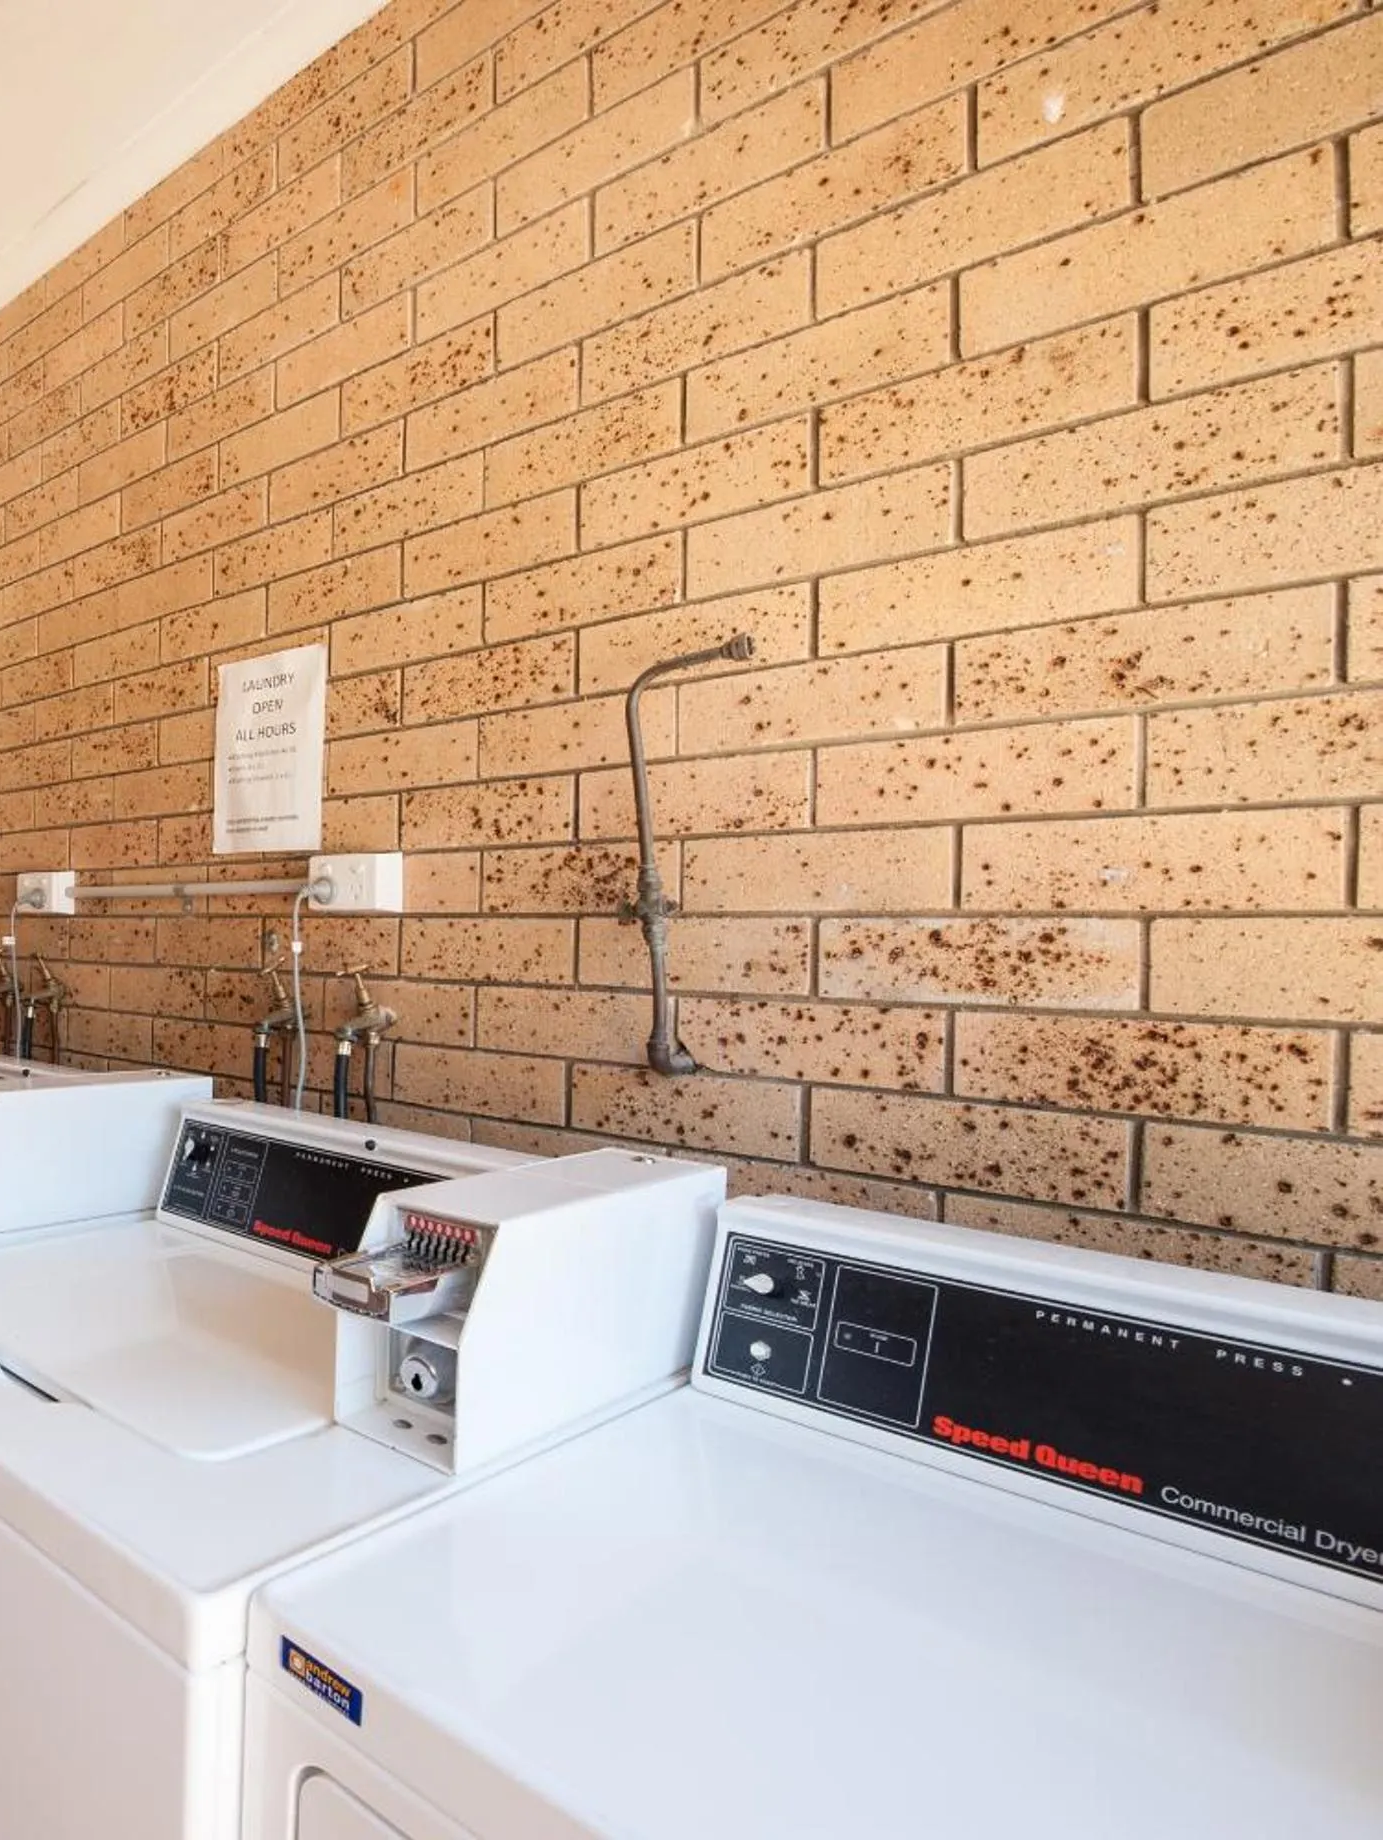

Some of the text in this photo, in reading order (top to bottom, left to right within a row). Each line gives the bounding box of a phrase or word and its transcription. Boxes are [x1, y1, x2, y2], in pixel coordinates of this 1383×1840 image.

[242, 672, 295, 693] LAUNDRY
[252, 699, 284, 714] OPEN
[236, 722, 296, 741] ALL HOURS
[1035, 1310, 1303, 1377] PERMANENT PRESS
[932, 1415, 1030, 1460] Speed
[1034, 1444, 1143, 1494] Queen
[1161, 1486, 1306, 1543] Commercial
